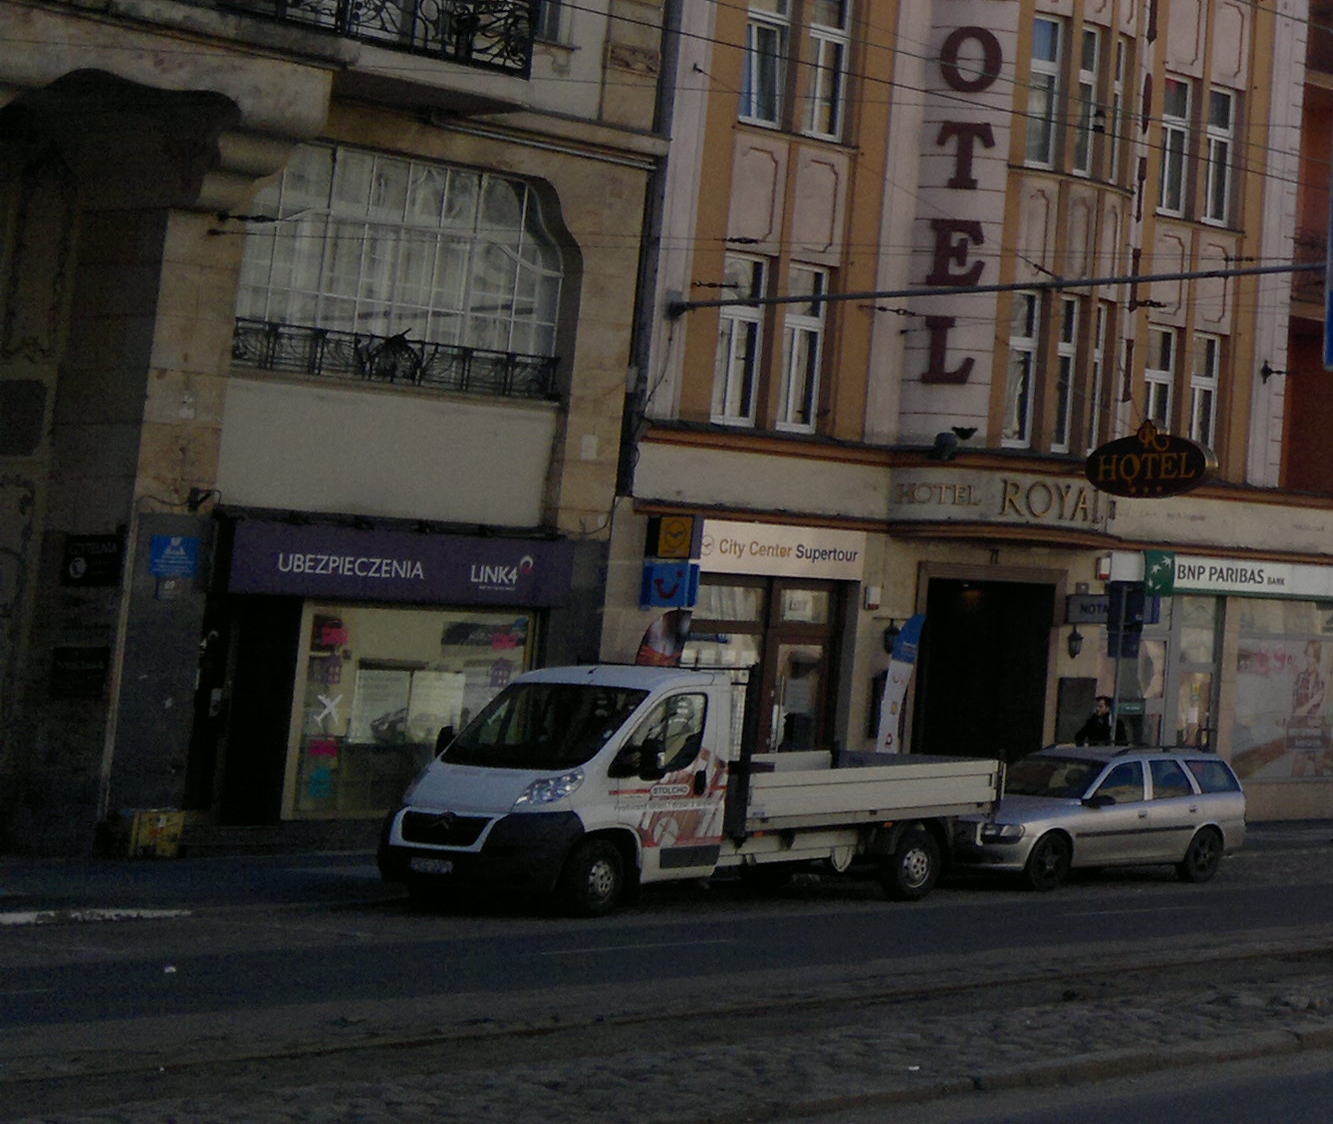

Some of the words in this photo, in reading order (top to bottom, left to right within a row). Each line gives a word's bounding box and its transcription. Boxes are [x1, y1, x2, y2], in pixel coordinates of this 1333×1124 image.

[1096, 451, 1198, 482] HOTEL
[895, 482, 982, 507] HOTEL
[999, 478, 1106, 524] ROYAL
[719, 538, 746, 558] City
[749, 540, 792, 558] Center
[795, 543, 859, 564] Supertour
[277, 551, 425, 581] UBEZPIECZENIA
[470, 564, 519, 585] LINK4
[1177, 563, 1207, 582] BNP
[1208, 566, 1265, 585] PARIBAS
[1267, 577, 1286, 586] BANK
